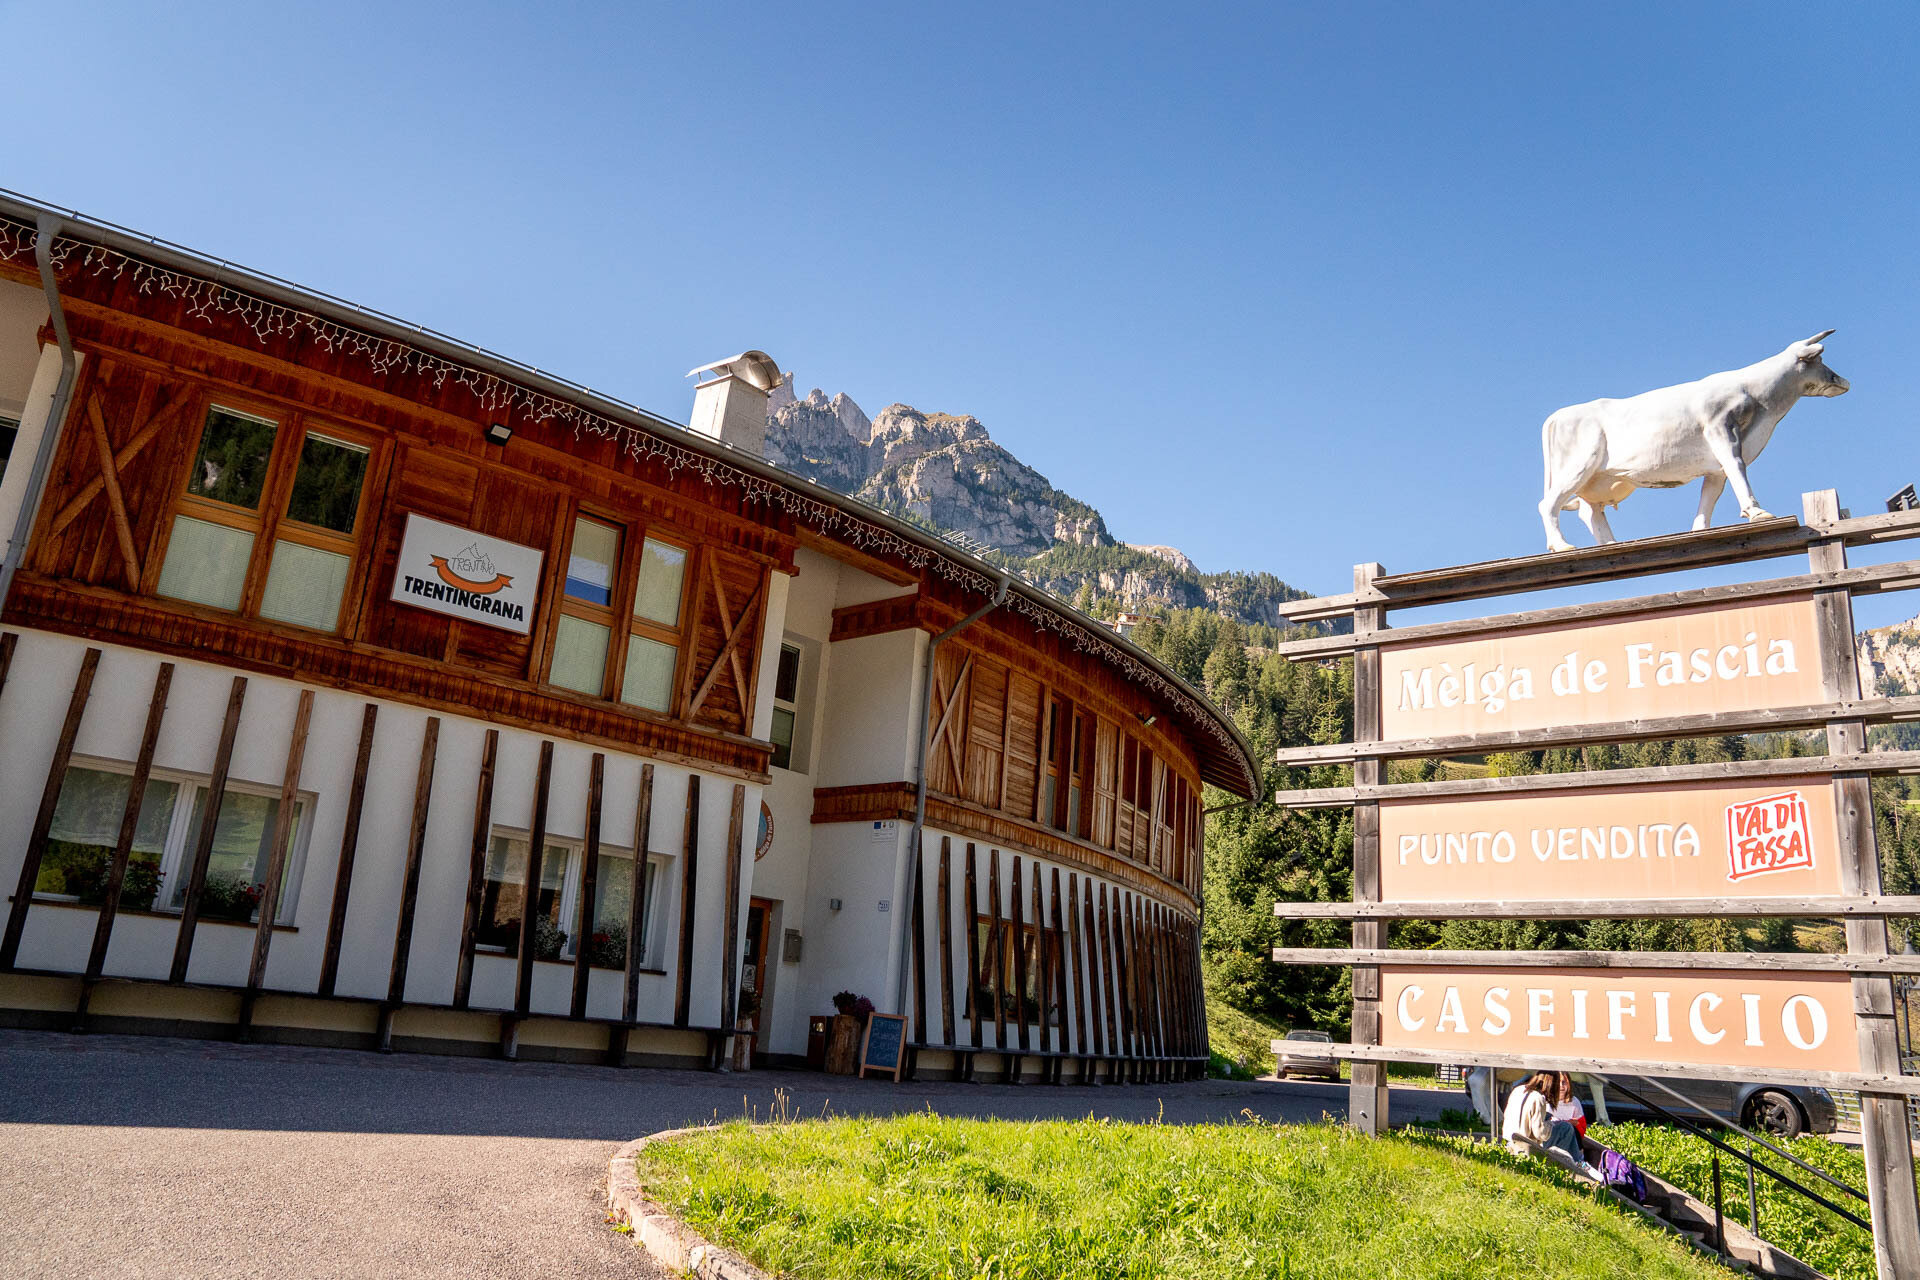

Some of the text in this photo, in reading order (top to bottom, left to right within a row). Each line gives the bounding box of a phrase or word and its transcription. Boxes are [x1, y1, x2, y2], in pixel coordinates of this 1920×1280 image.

[451, 557, 496, 575] TRENTINO
[404, 575, 524, 622] TRENTINGRANA
[1397, 631, 1800, 715] Mèlga de Fascia
[1736, 806, 1773, 837] VAL
[1398, 823, 1702, 866] PUNTO VENDITA
[1737, 830, 1804, 870] FASSA
[1396, 984, 1828, 1050] CASEIFICIO
